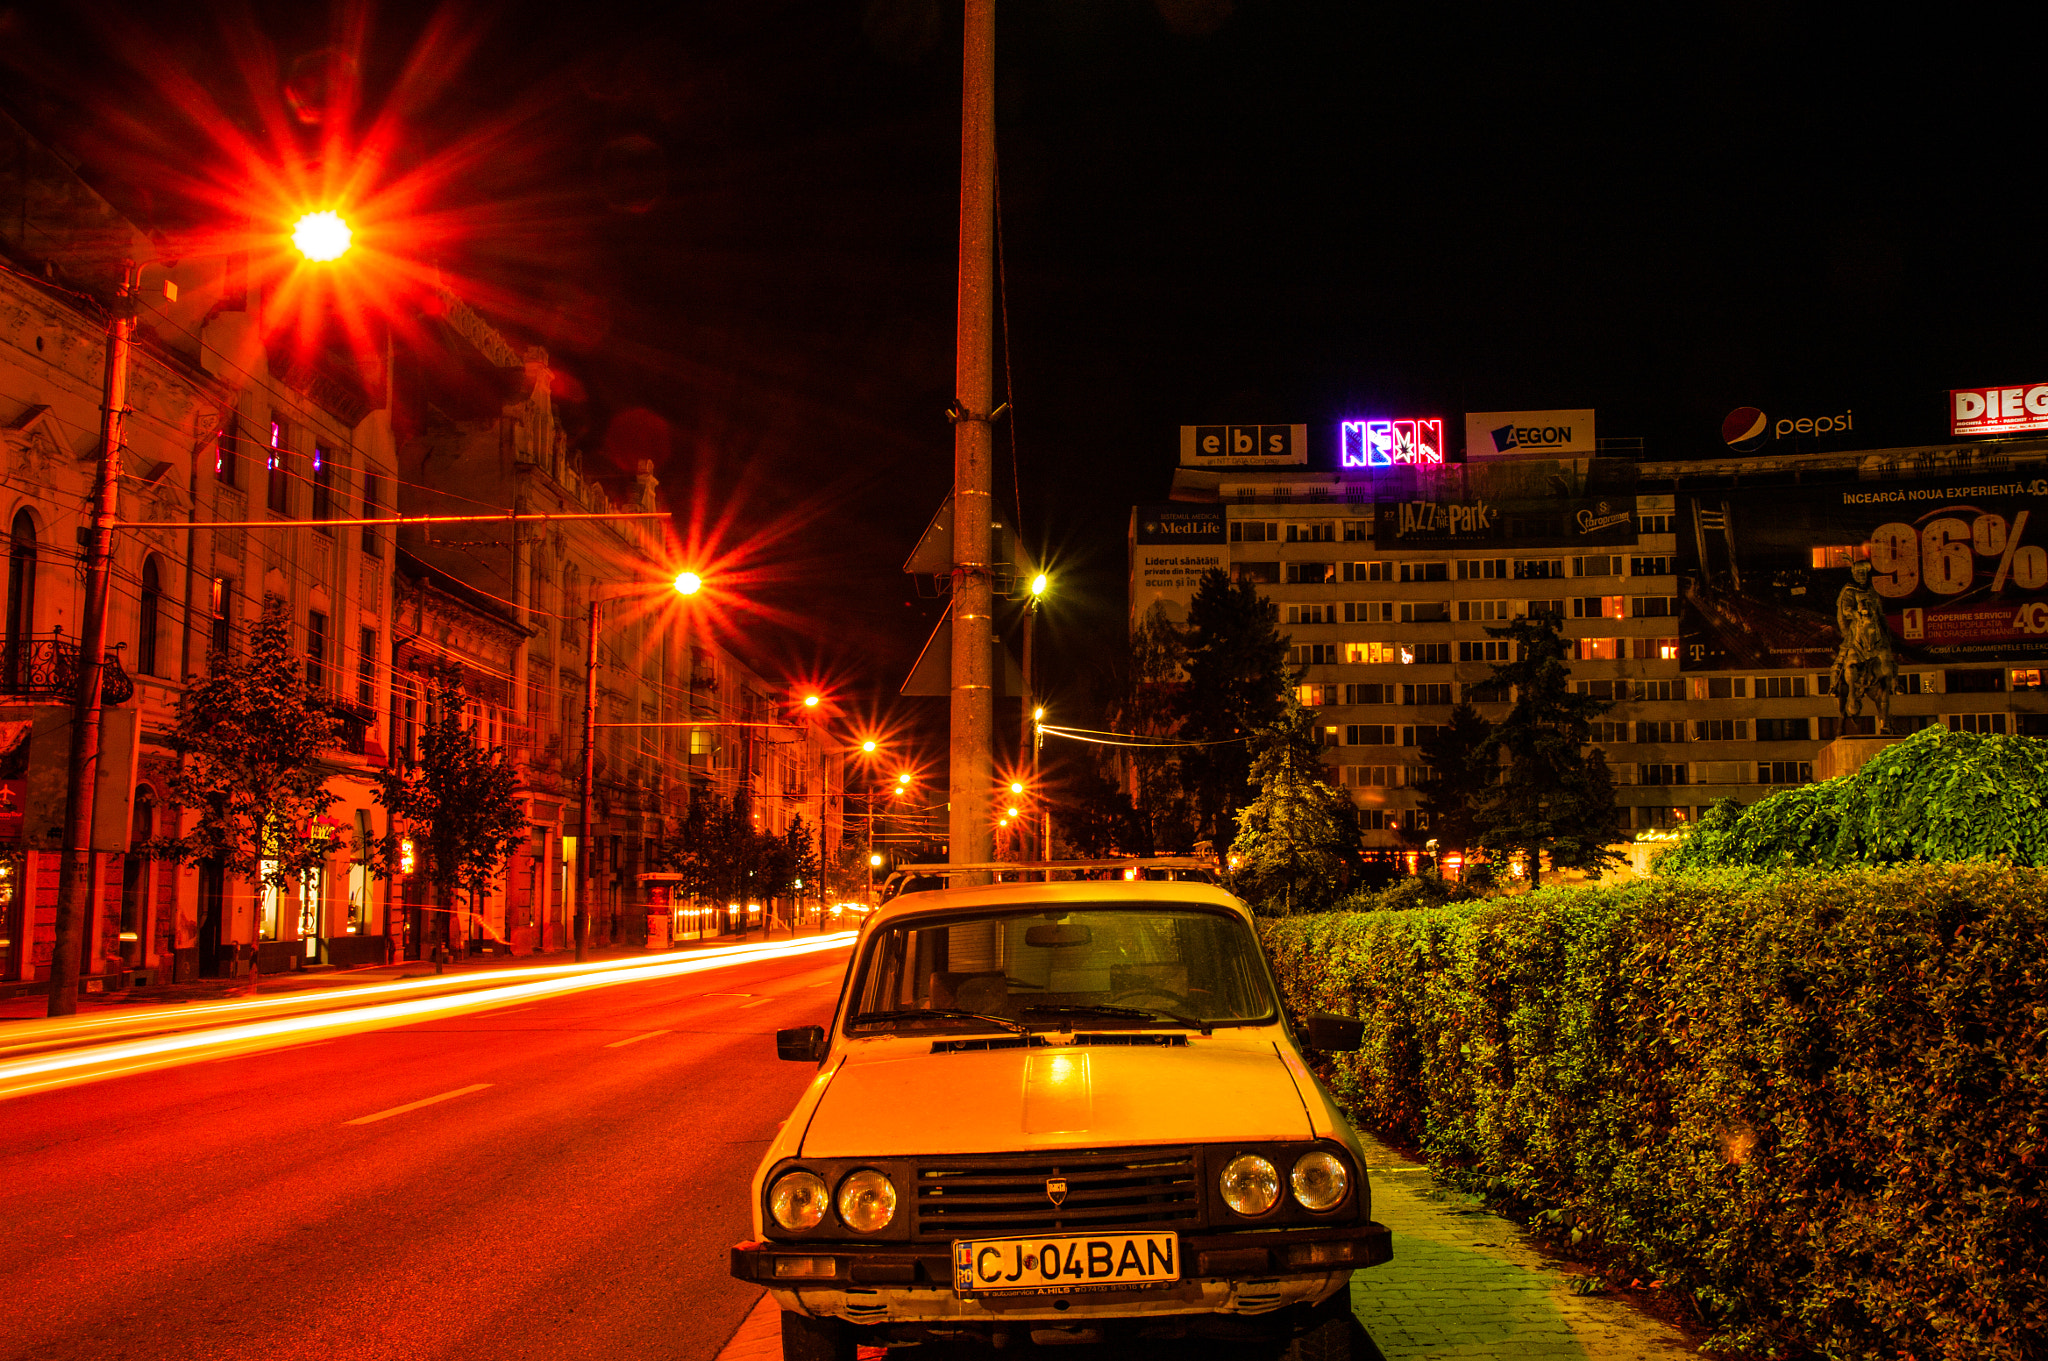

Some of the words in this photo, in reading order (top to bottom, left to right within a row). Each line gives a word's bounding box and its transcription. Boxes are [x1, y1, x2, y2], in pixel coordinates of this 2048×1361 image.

[1955, 386, 2048, 420] DIEG
[1505, 427, 1571, 445] AEGON
[1775, 409, 1853, 440] pepsi
[1202, 428, 1284, 454] ebs
[1341, 419, 1442, 466] NEON
[1843, 489, 1906, 505] ÎNCEARCĂ
[1908, 487, 1944, 501] NOUA
[1160, 521, 1220, 535] MedLife
[1395, 500, 1437, 538] JAZZ
[1448, 499, 1490, 535] Park
[1576, 509, 1631, 535] Staropramen
[1145, 557, 1178, 566] Liderul
[1870, 510, 2048, 598] 96%
[1145, 579, 1173, 587] acum
[1187, 577, 1197, 587] în
[1905, 609, 1917, 629] 1
[1927, 613, 1973, 622] ACOPERIRE
[1974, 611, 2011, 620] SERVICIU
[2013, 602, 2048, 634] 4G
[977, 1246, 1023, 1283] CJ
[1037, 1286, 1070, 1295] A.HILS
